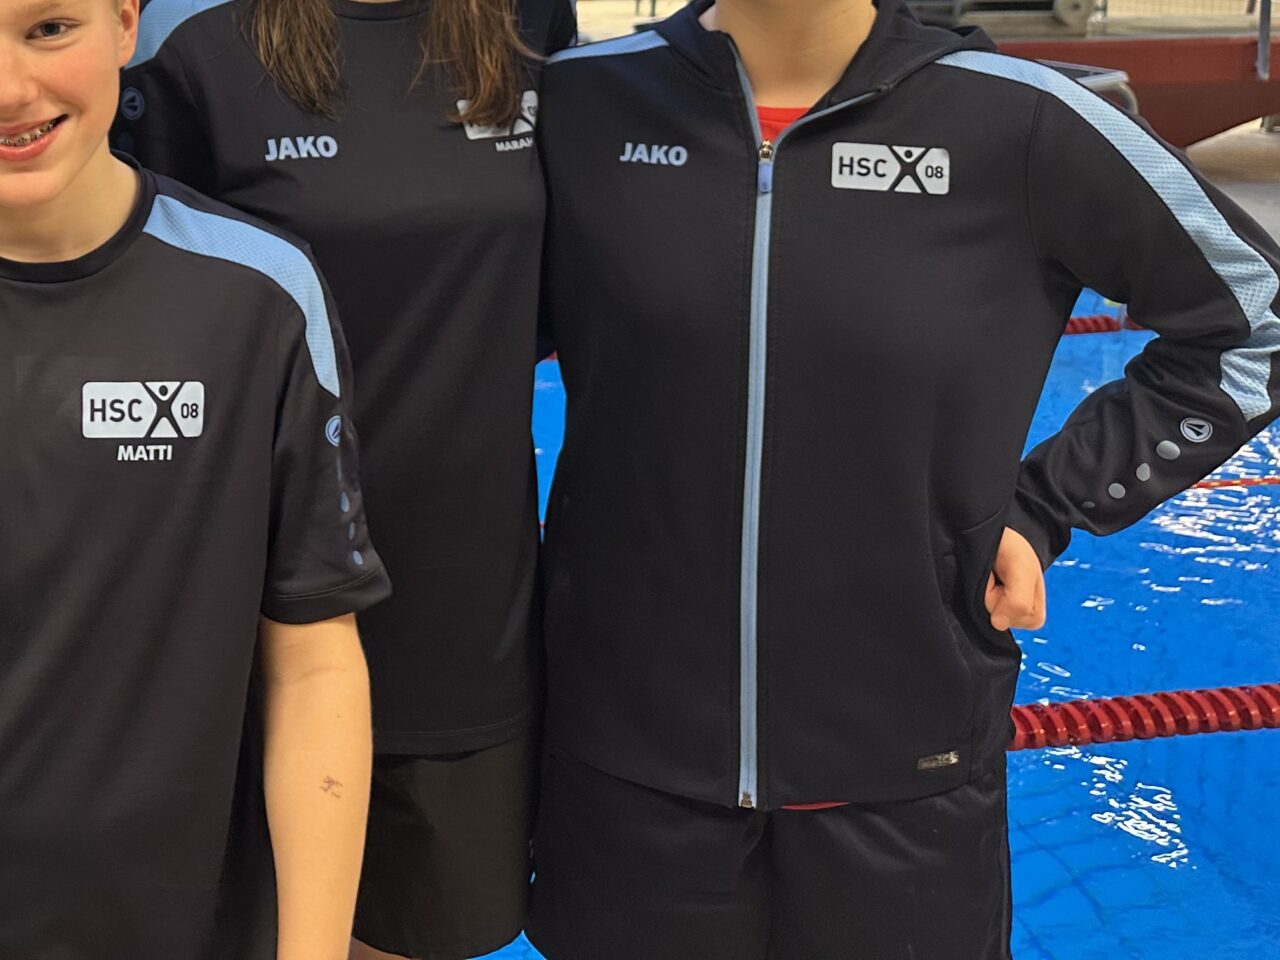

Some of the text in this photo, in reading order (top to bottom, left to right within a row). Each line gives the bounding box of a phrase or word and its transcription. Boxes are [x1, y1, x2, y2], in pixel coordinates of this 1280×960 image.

[265, 135, 338, 161] JAKO
[619, 142, 688, 166] JAKO
[838, 156, 944, 178] HSC 08
[89, 398, 199, 423] HSC 08
[117, 444, 173, 461] MATTI
